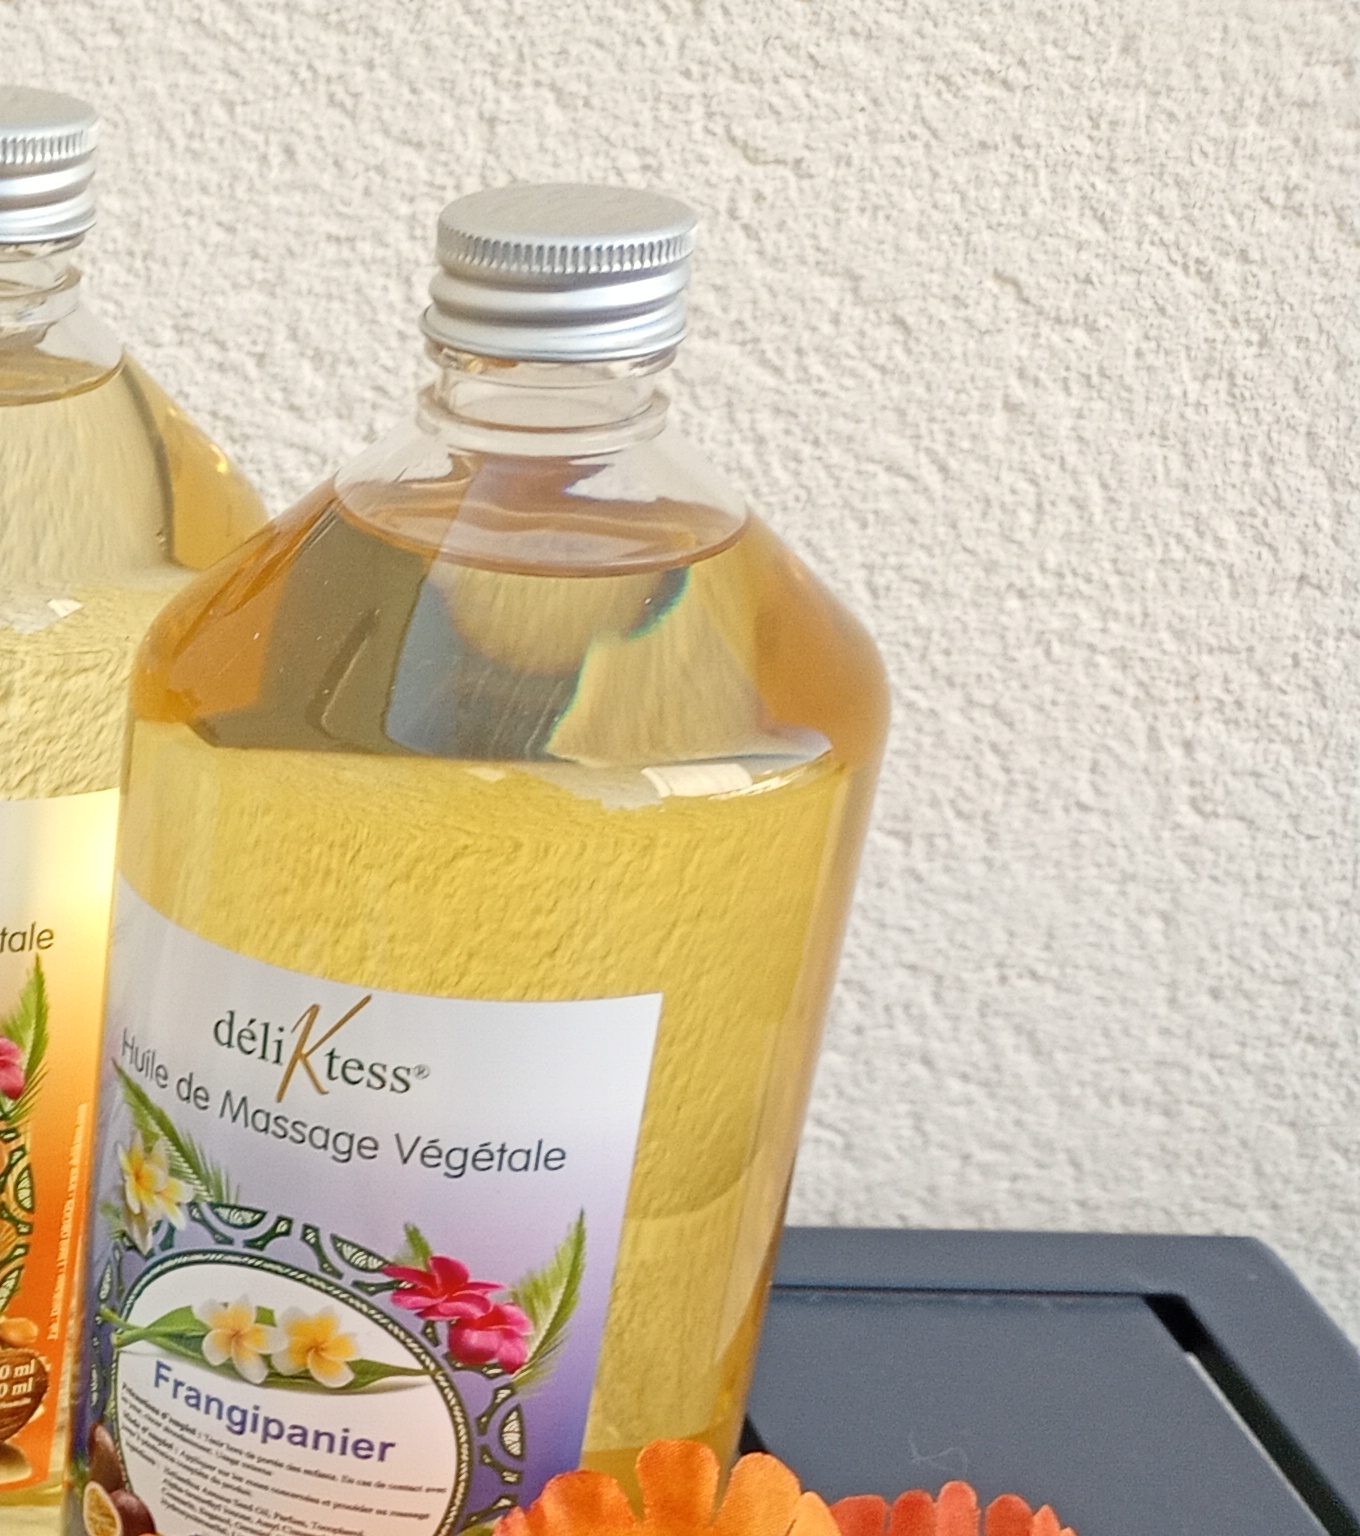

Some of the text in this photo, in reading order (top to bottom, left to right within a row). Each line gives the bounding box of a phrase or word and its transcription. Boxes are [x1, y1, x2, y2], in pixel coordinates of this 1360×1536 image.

[122, 1028, 567, 1179] Huile de Massage Végétale
[154, 1360, 396, 1463] Frangipanier
